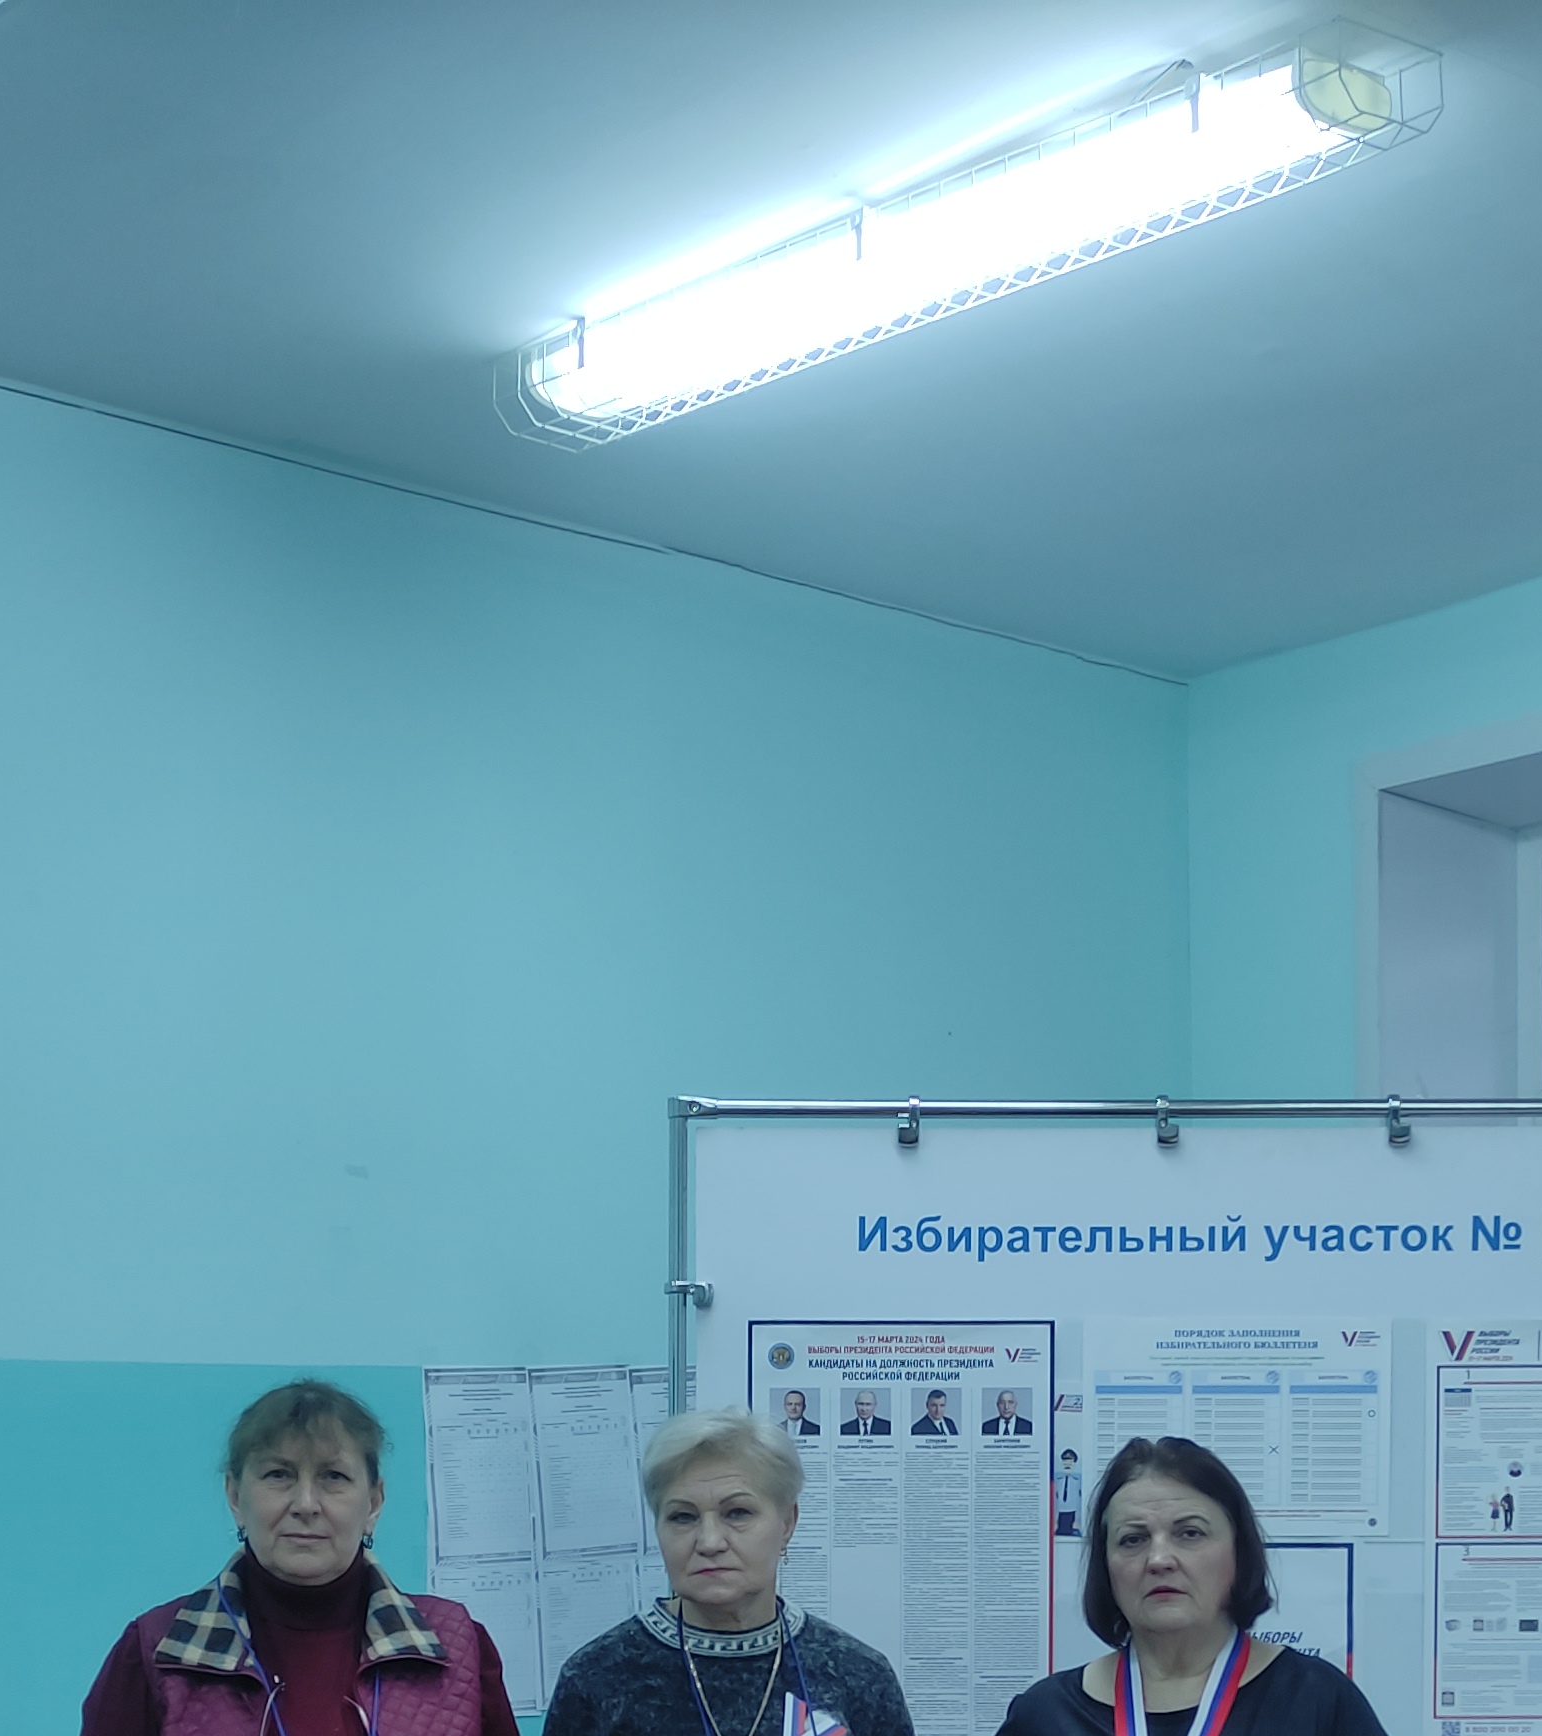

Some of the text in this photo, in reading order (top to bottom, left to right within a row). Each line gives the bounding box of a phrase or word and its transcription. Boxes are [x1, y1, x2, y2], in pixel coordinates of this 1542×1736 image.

[857, 1213, 1248, 1263] Избирательный
[1263, 1222, 1455, 1263] участок
[1471, 1214, 1523, 1252] №
[1174, 1329, 1301, 1338] ПОРЯДОК ЗАПОЛНЕНИЯ
[877, 1335, 904, 1344] МАРТА
[905, 1335, 923, 1344] 2024
[925, 1335, 946, 1344] ГОДА
[1156, 1341, 1319, 1349] ИЗБИРАТЕЛЬНОГО БЮЛЛЕТЕНЯ
[807, 1344, 995, 1355] ВЫБОРЫ ПРЕЗИДЕНТА РОССИЙСКОЙ ФЕДЕРАЦИИ
[808, 1358, 995, 1369] КАНДИДАТЫ НА ДОЛЖНОСТЬ ПРЕЗИДЕНТА
[842, 1369, 961, 1382] РОССИЙСКОЙ ФЕДЕРАЦИИ
[1462, 1546, 1470, 1557] 3
[1248, 1631, 1304, 1644] ЫБОРЫ
